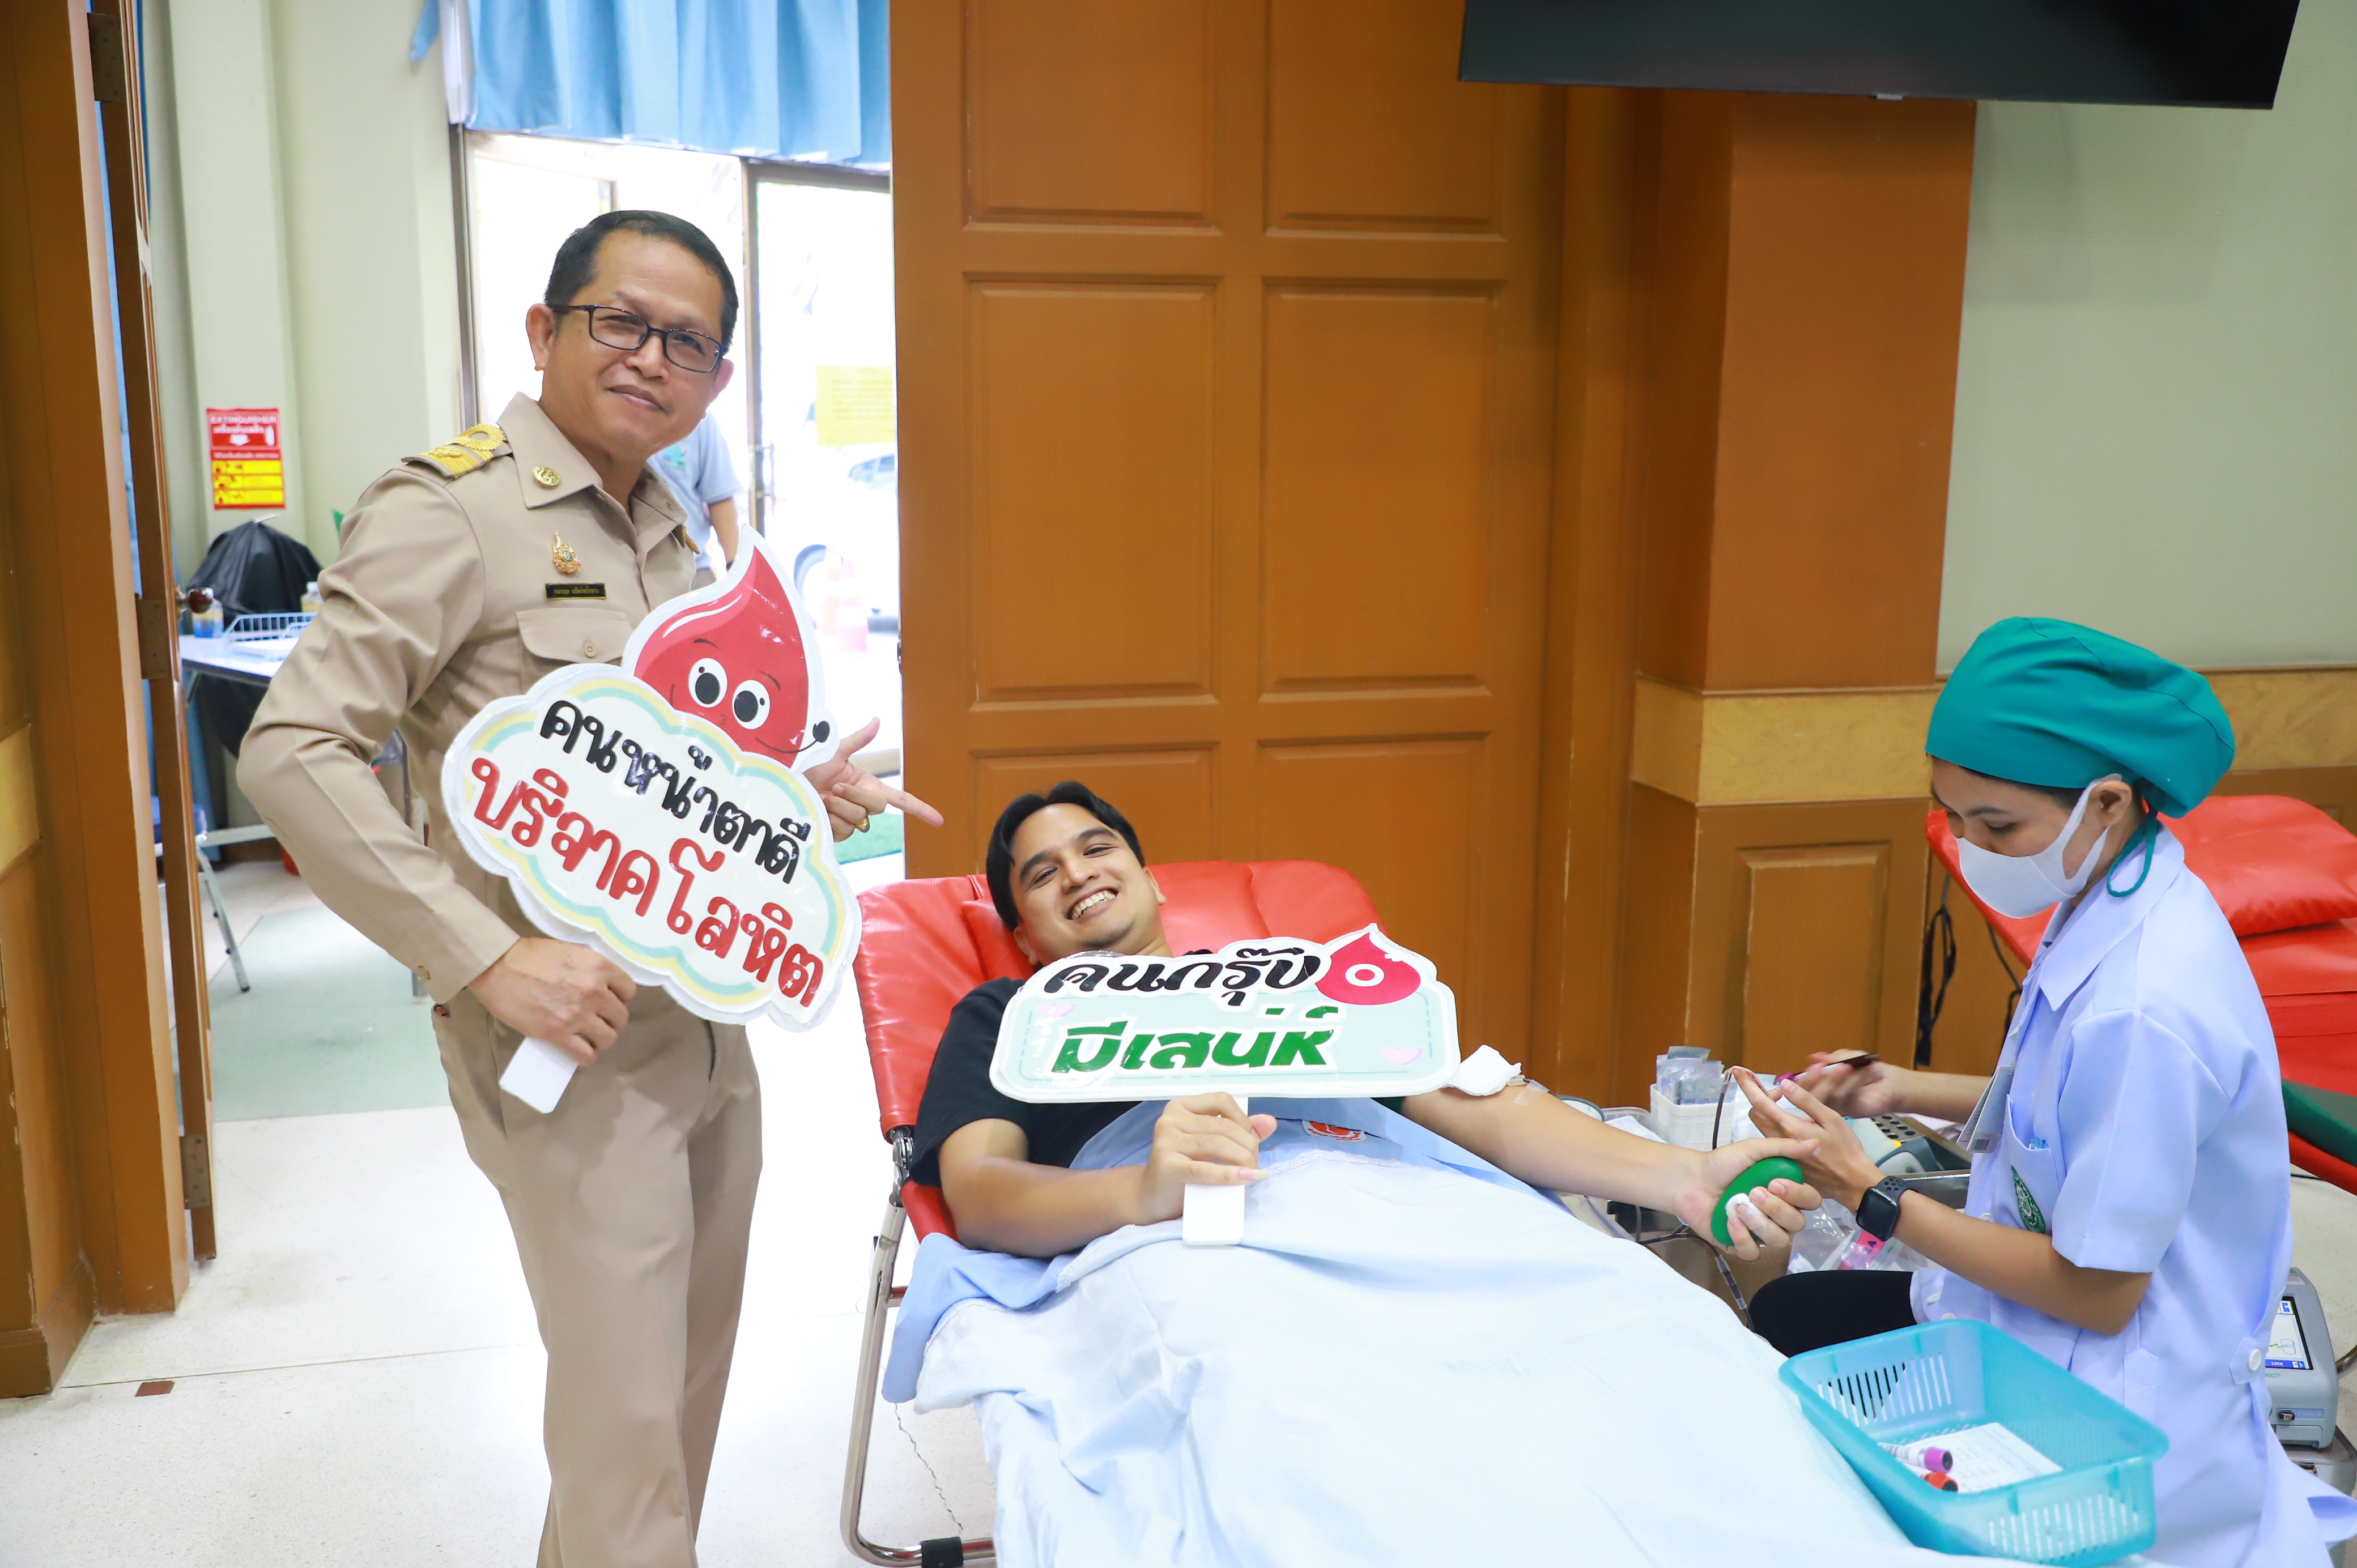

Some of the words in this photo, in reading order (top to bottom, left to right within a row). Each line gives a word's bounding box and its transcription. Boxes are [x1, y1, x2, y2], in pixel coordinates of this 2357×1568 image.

[539, 700, 812, 884] คนหน้าตาดี
[471, 757, 824, 1008] บริจาคโลหิต
[1044, 947, 1321, 1007] คนกรุ๊ป
[1051, 1005, 1339, 1073] มีเสน่ห์
